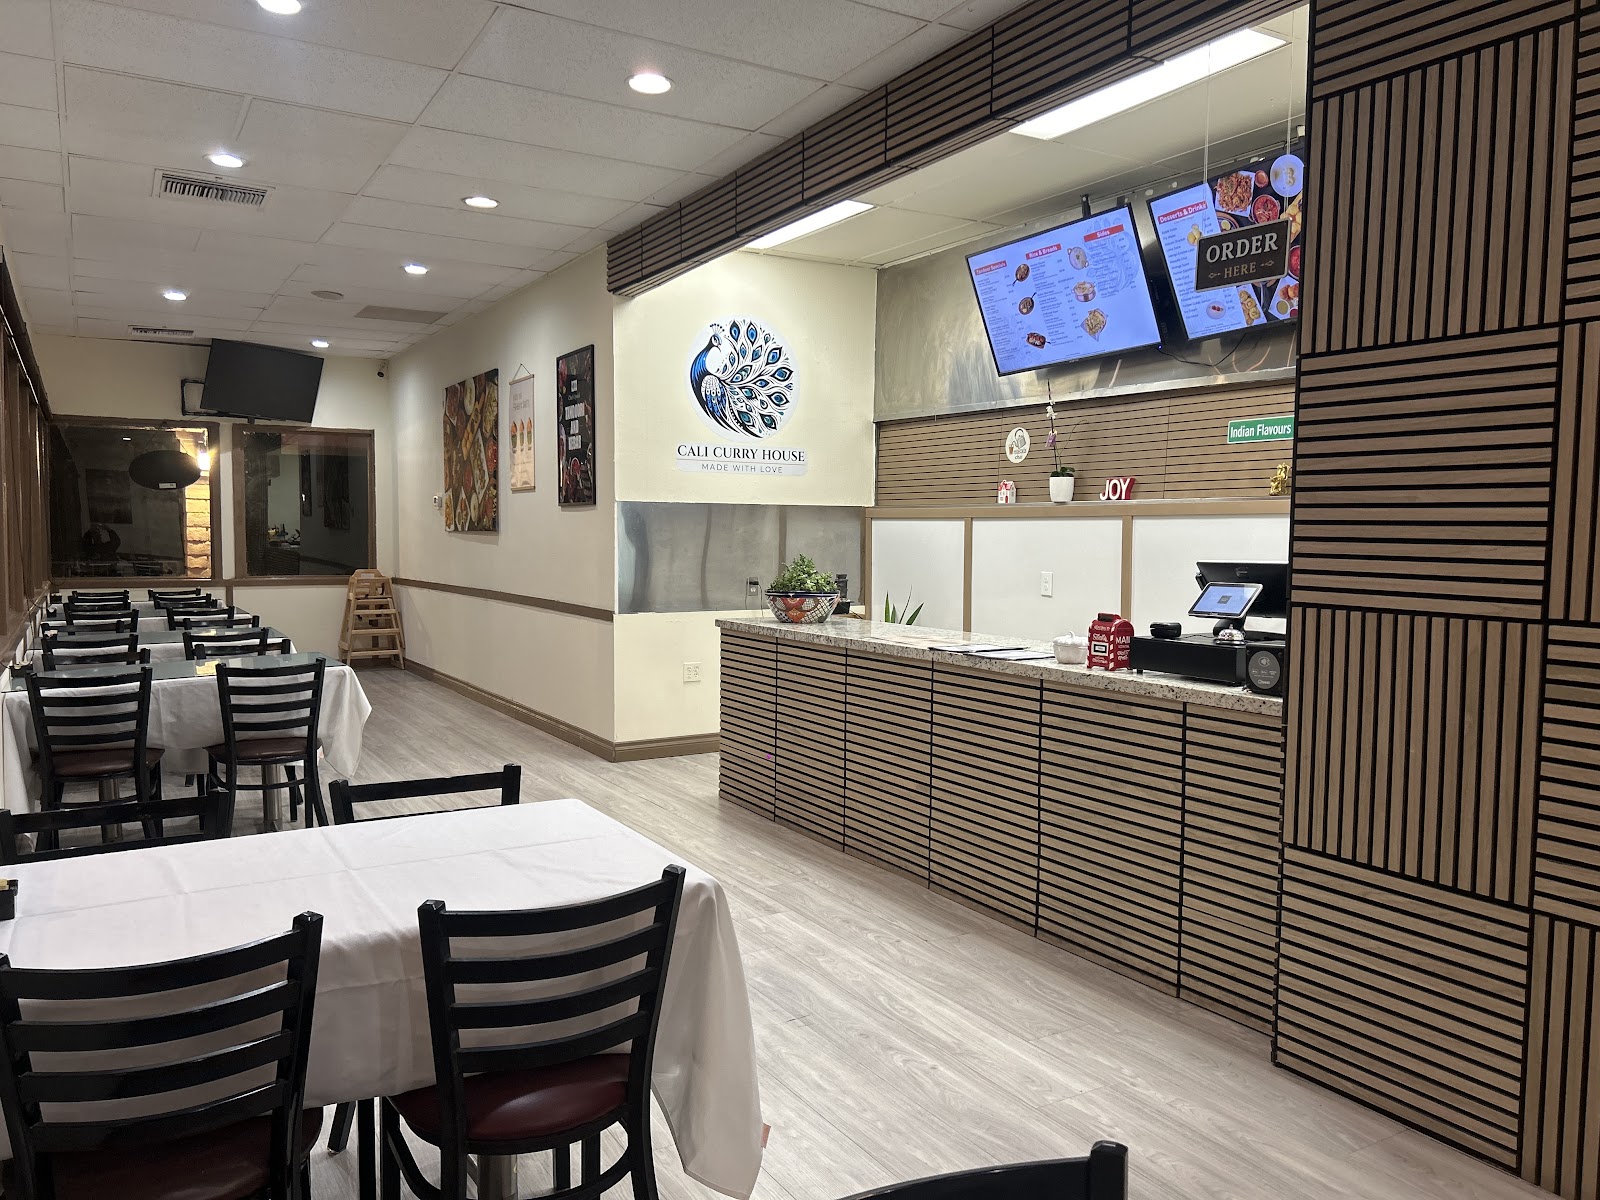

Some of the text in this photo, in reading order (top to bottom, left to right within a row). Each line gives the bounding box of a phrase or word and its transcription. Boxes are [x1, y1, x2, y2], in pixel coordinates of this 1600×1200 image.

[1160, 211, 1182, 223] Desserts
[1206, 232, 1278, 263] ORDER
[1224, 262, 1257, 279] HERE
[1230, 424, 1292, 438] Indian Flavours
[677, 444, 805, 462] CALI CURRY HOUSE
[701, 463, 783, 473] MADE WITH LOVE
[1099, 478, 1131, 500] JOY
